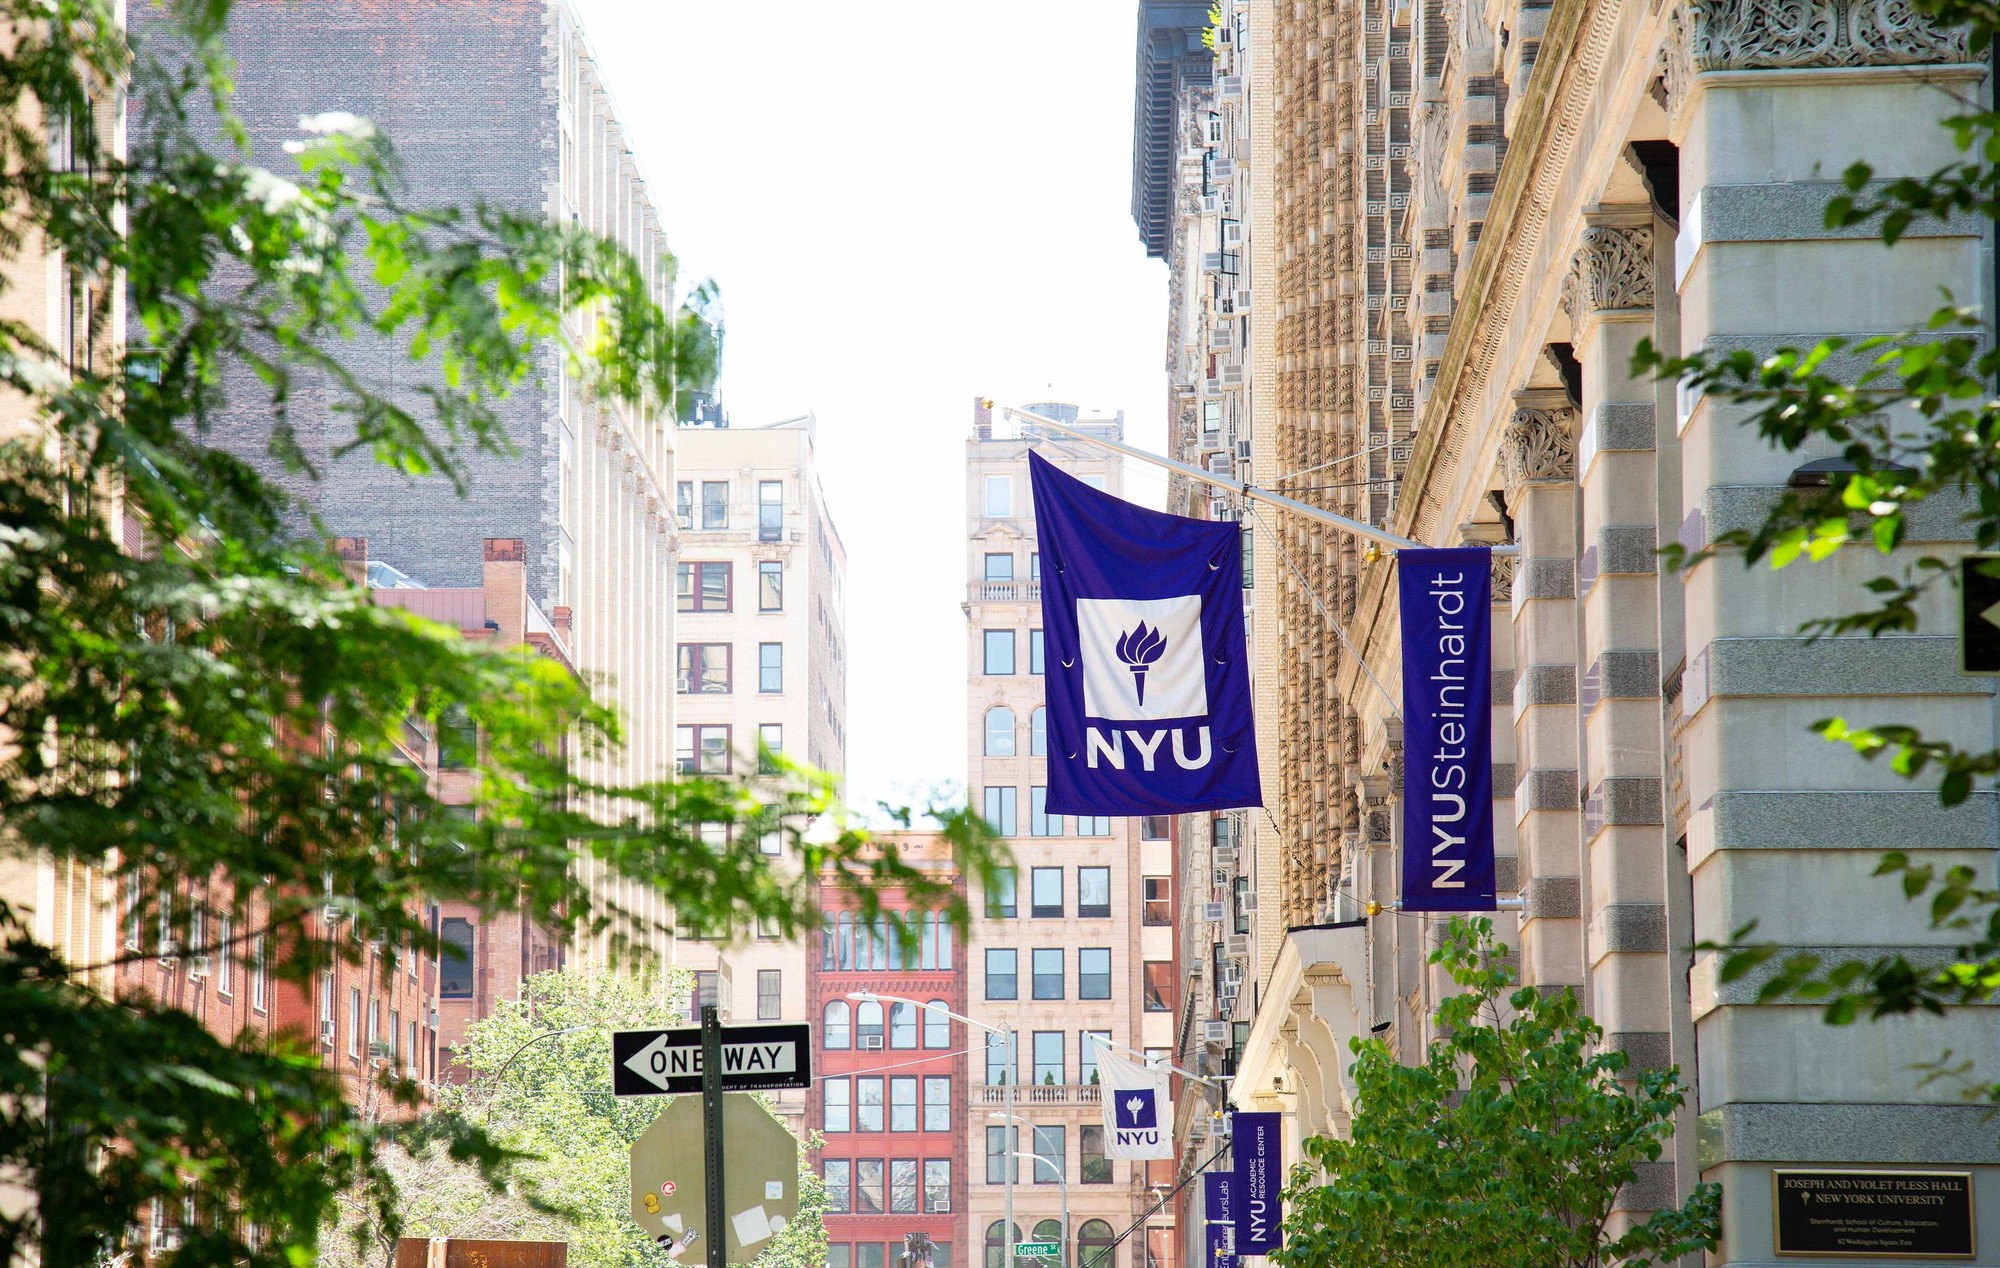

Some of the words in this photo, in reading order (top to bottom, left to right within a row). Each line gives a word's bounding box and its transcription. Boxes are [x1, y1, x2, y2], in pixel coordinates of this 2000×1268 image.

[1086, 726, 1212, 772] NYU
[650, 1049, 703, 1074] ONE
[724, 1045, 783, 1071] WAY
[1117, 1131, 1158, 1145] NYU
[1249, 1158, 1257, 1198] ACADEMIC
[1783, 1179, 1825, 1189] JOSEPH
[1826, 1180, 1851, 1189] AND
[1852, 1180, 1894, 1190] VIOLET
[1896, 1181, 1929, 1191] PLESS
[1931, 1182, 1962, 1191] HALL
[1815, 1194, 1842, 1203] NEW
[1843, 1194, 1875, 1204] YORK
[1877, 1195, 1946, 1205] UNIVERSITY
[1250, 1200, 1266, 1242] NYU
[1018, 1245, 1048, 1255] Greene
